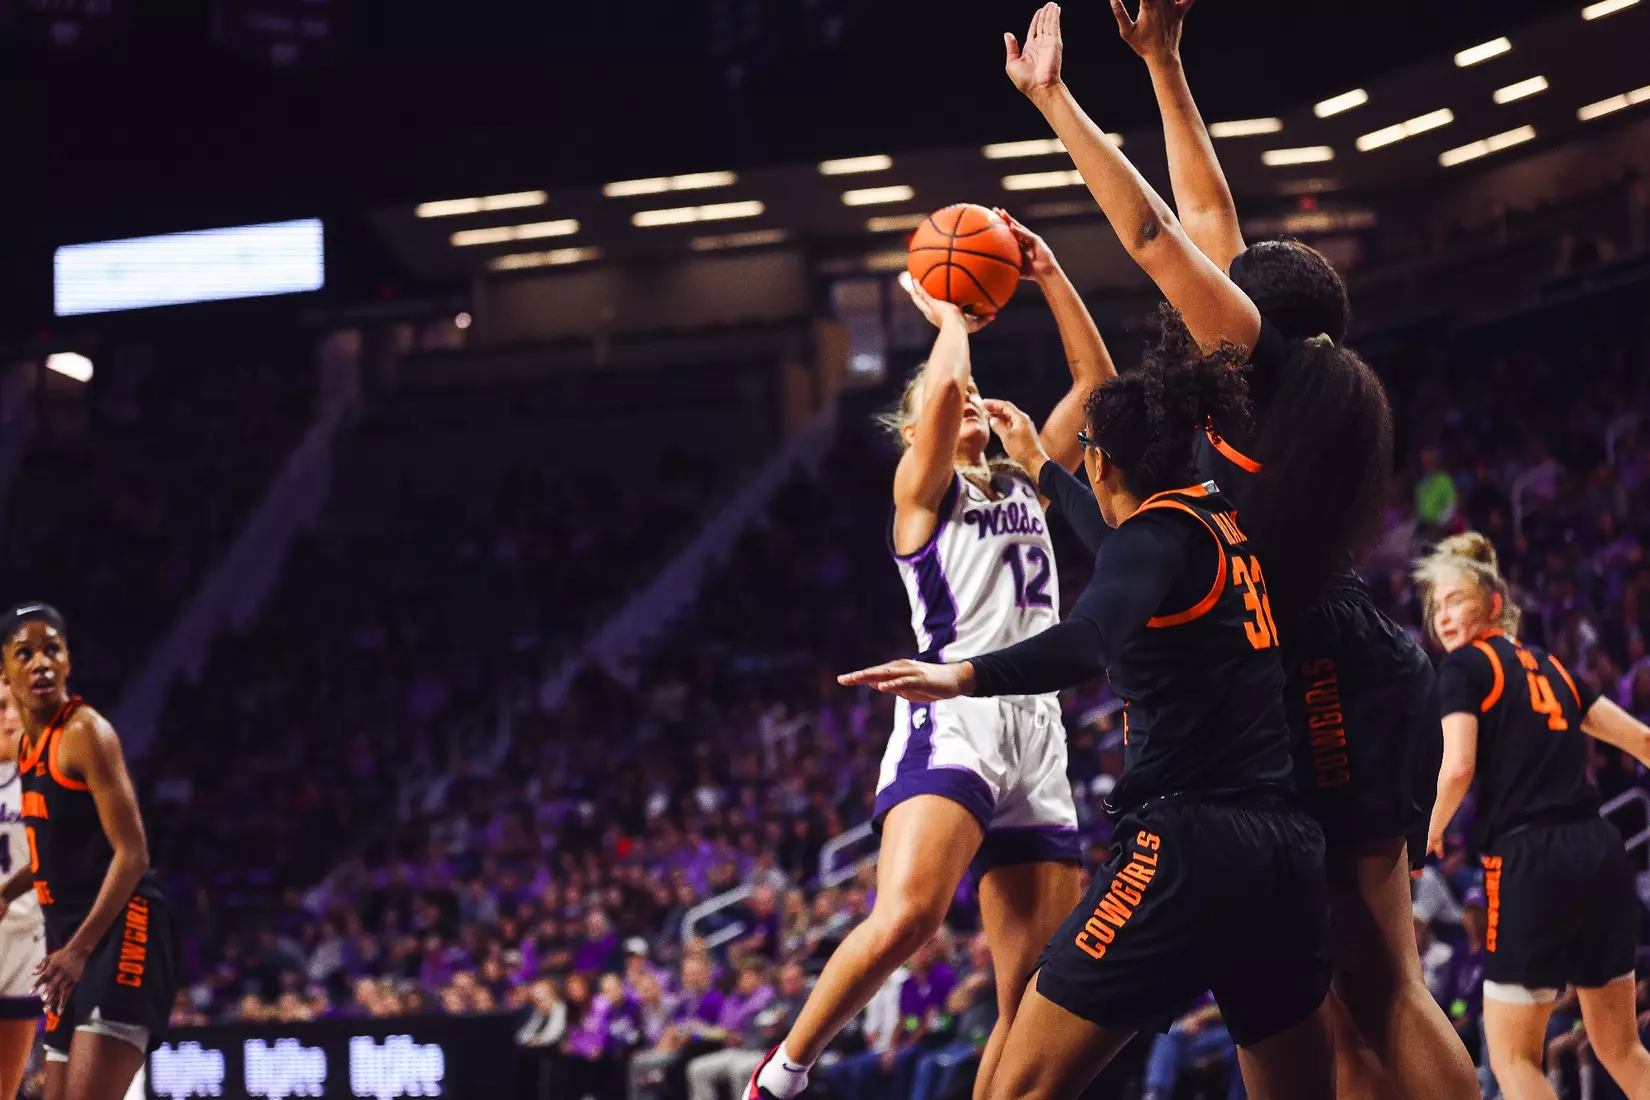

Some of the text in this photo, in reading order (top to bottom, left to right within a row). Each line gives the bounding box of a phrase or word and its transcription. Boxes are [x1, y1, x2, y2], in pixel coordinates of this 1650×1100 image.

[1002, 541, 1054, 610] 12
[1301, 656, 1351, 790] COWGIRLS
[1525, 671, 1569, 732] 4
[1075, 829, 1161, 960] COWGIRLS
